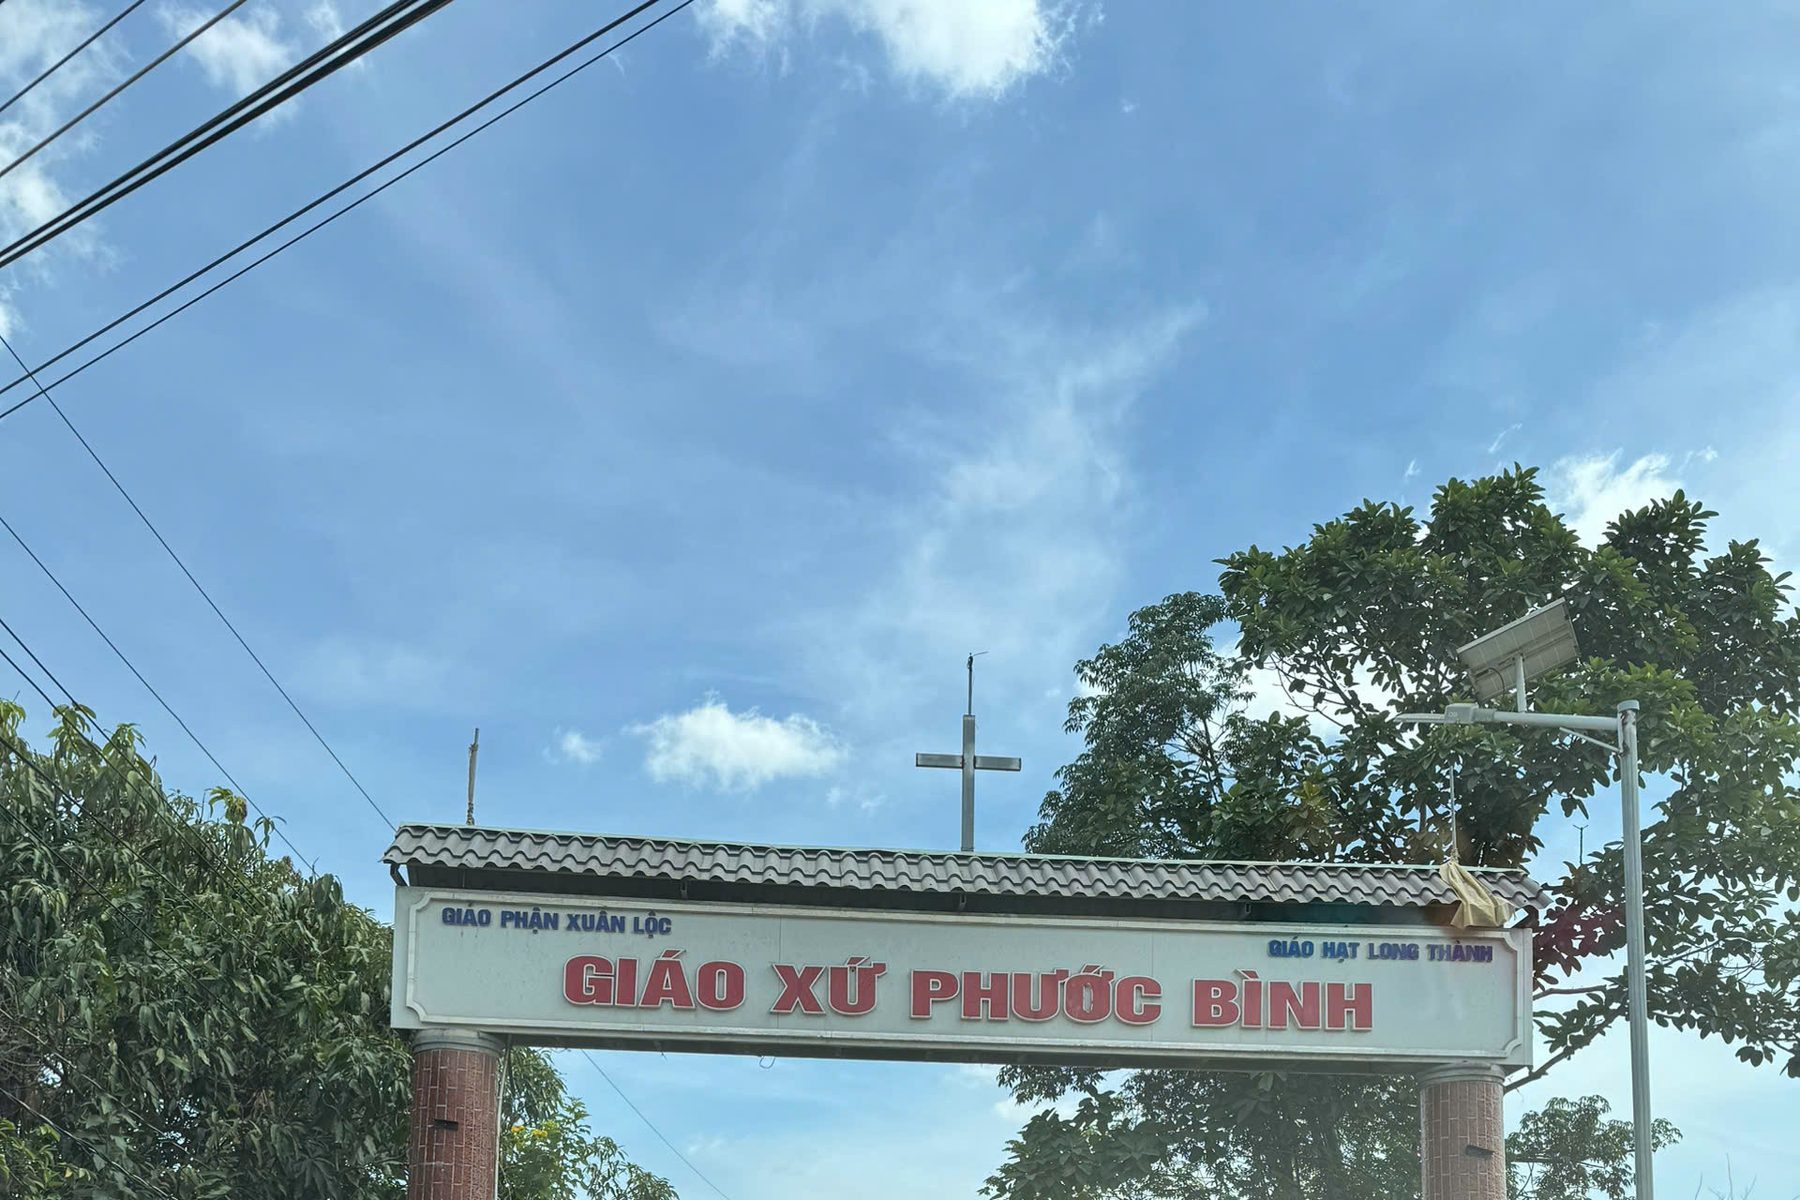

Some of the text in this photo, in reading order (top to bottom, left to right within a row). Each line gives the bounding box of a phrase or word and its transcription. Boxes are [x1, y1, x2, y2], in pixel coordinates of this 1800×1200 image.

[441, 902, 672, 939] GIÁO PHẬN XUÂN LỘC
[1268, 936, 1493, 963] GIÁO HẠT LONG THÀNH
[562, 949, 1373, 1031] GIÁO XỨ PHƯỚC BÌNH
